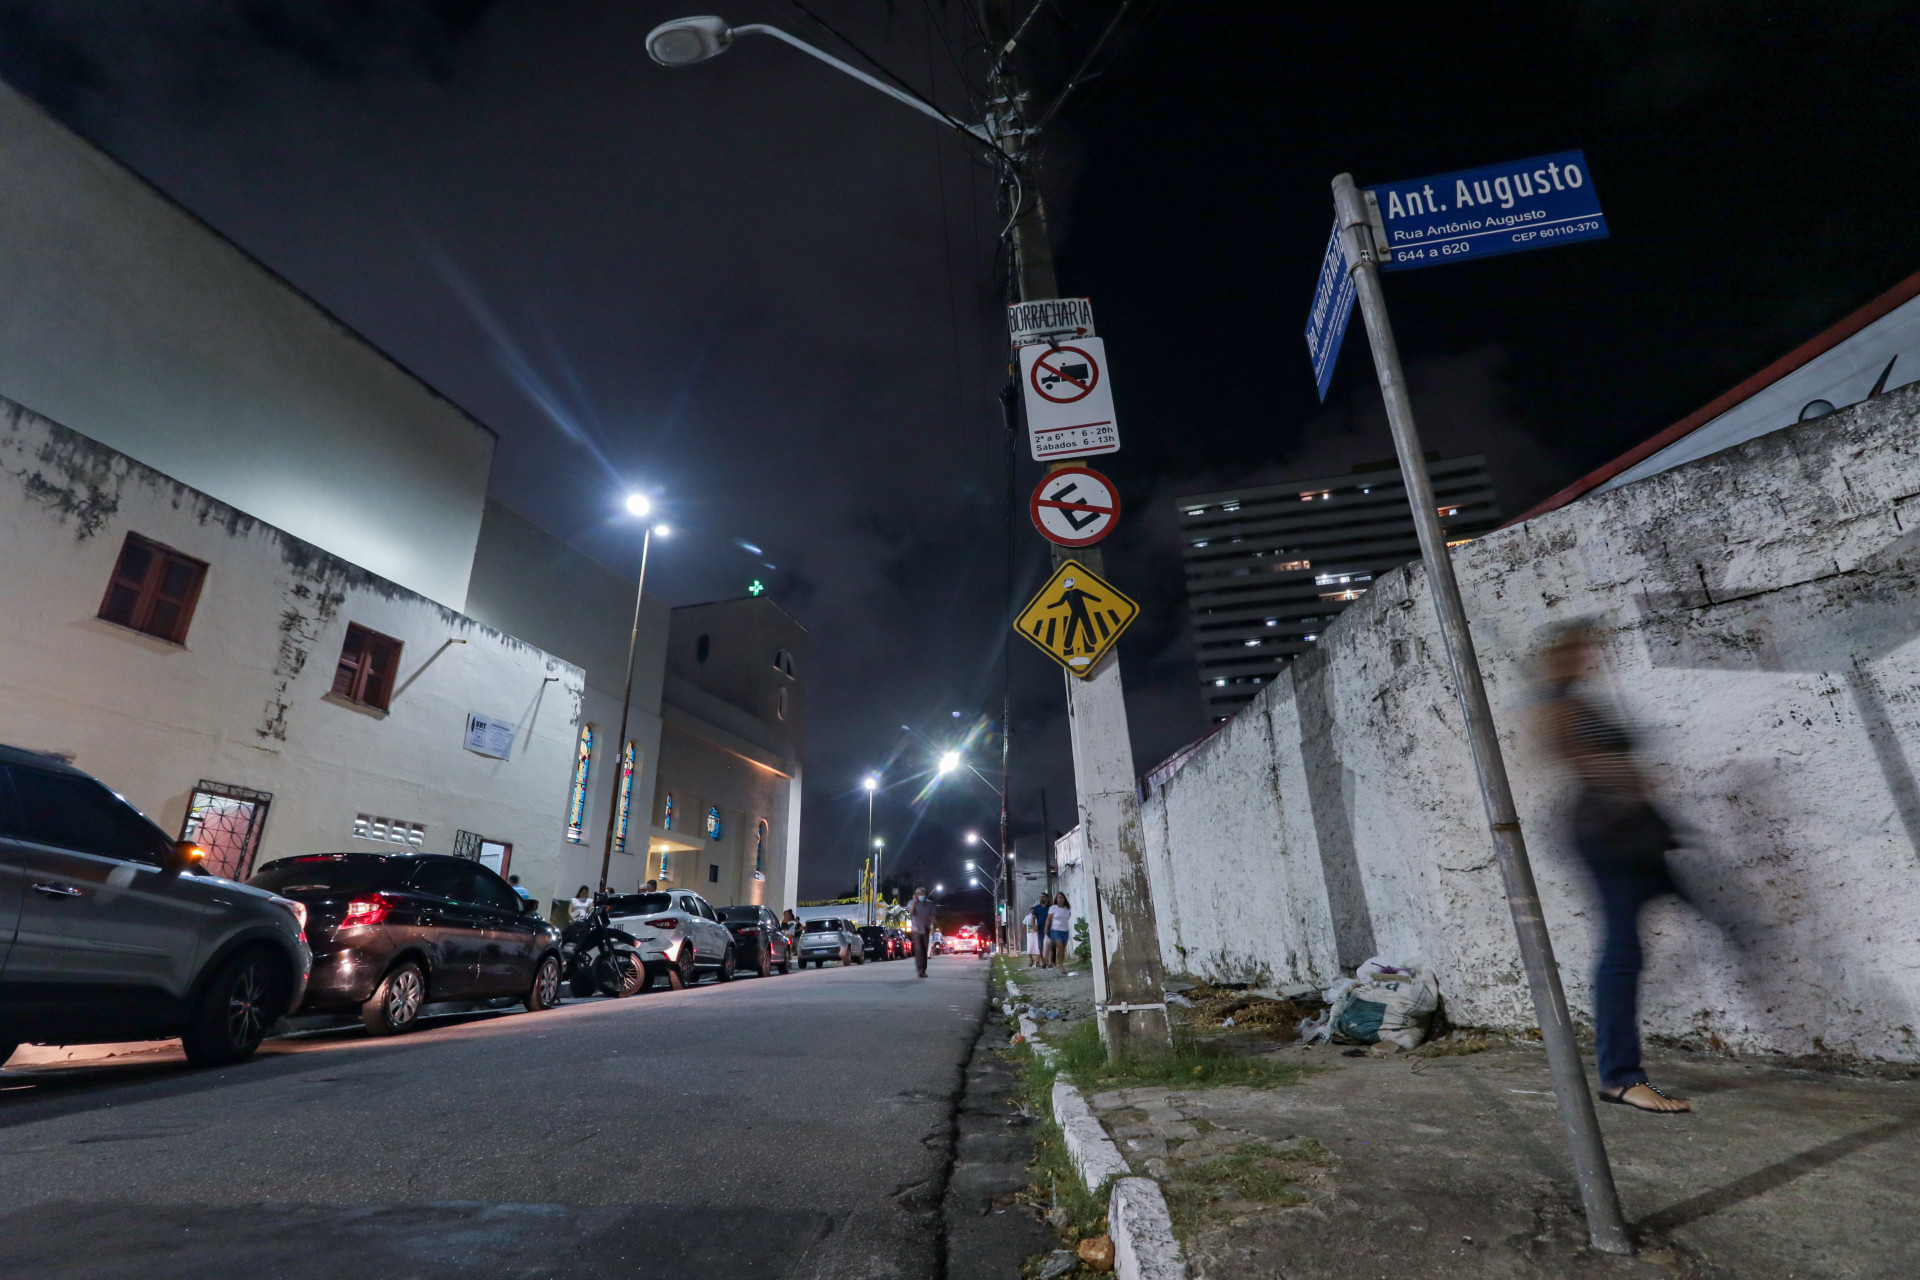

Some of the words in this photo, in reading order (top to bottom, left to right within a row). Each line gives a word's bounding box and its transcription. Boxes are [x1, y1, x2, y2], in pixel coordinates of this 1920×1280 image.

[1388, 184, 1447, 219] Ant.
[1456, 162, 1583, 208] Augusto
[1394, 229, 1423, 241] Rua
[1427, 220, 1482, 237] Antônio
[1485, 210, 1546, 228] Augusto
[1512, 231, 1537, 242] CEP
[1540, 221, 1599, 238] 60110-370
[1398, 249, 1424, 262] 644
[1429, 248, 1439, 258] a
[1442, 242, 1470, 255] 620
[1008, 300, 1093, 333] BORRACHARIA
[1036, 441, 1077, 452] Sábados
[1083, 438, 1089, 446] 6
[1097, 435, 1115, 444] 13h
[1082, 429, 1088, 437] 6
